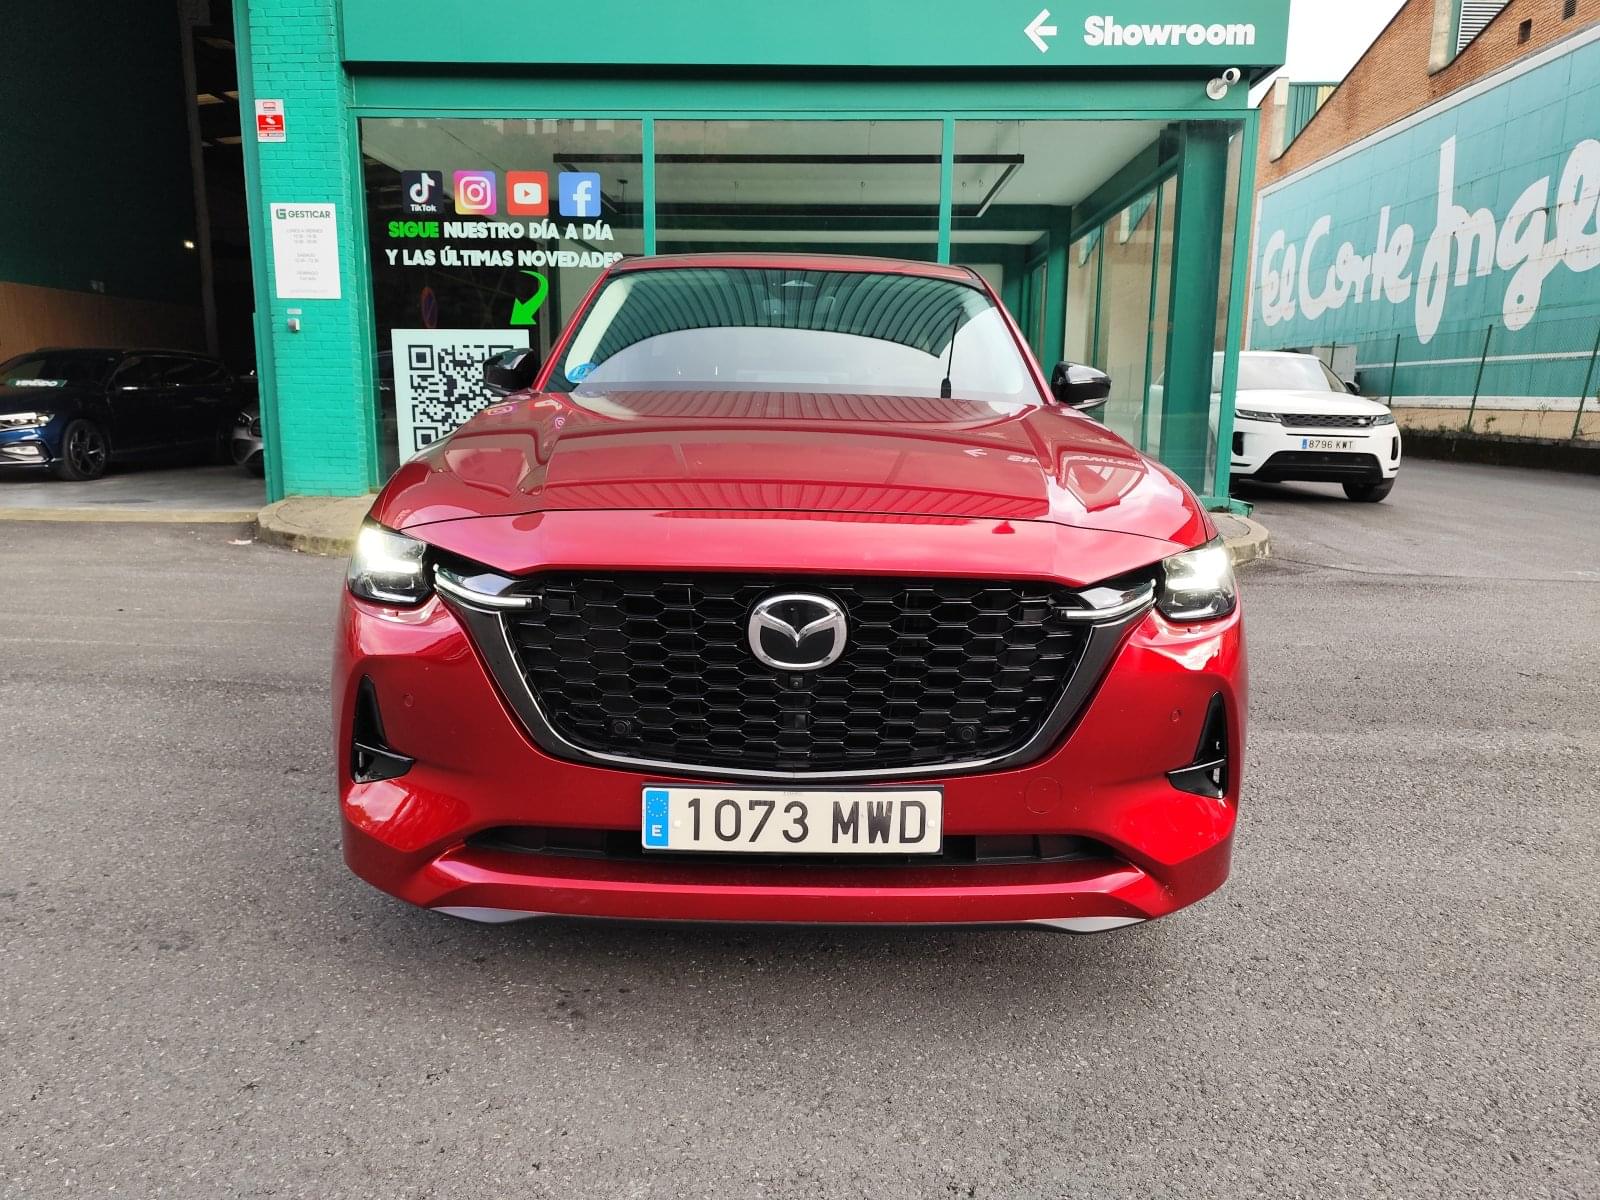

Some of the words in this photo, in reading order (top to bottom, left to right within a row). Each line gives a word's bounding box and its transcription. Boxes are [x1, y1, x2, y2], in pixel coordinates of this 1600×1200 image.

[1083, 15, 1255, 46] Showroom
[287, 210, 331, 219] GESTICAR
[410, 204, 437, 212] TikTok
[388, 221, 440, 238] SIGUE
[443, 221, 525, 239] NUESTRO
[528, 218, 560, 240] DÍA
[564, 222, 579, 240] A
[582, 219, 614, 241] DÍA
[384, 249, 399, 266] Y
[402, 249, 436, 266] LAS
[440, 245, 514, 267] ÚLTIMAS
[1261, 229, 1297, 327] El
[1298, 205, 1415, 321] Corte
[1308, 439, 1333, 449] 8796
[651, 824, 662, 837] E
[687, 798, 809, 843] 1073
[831, 800, 926, 844] MWD
